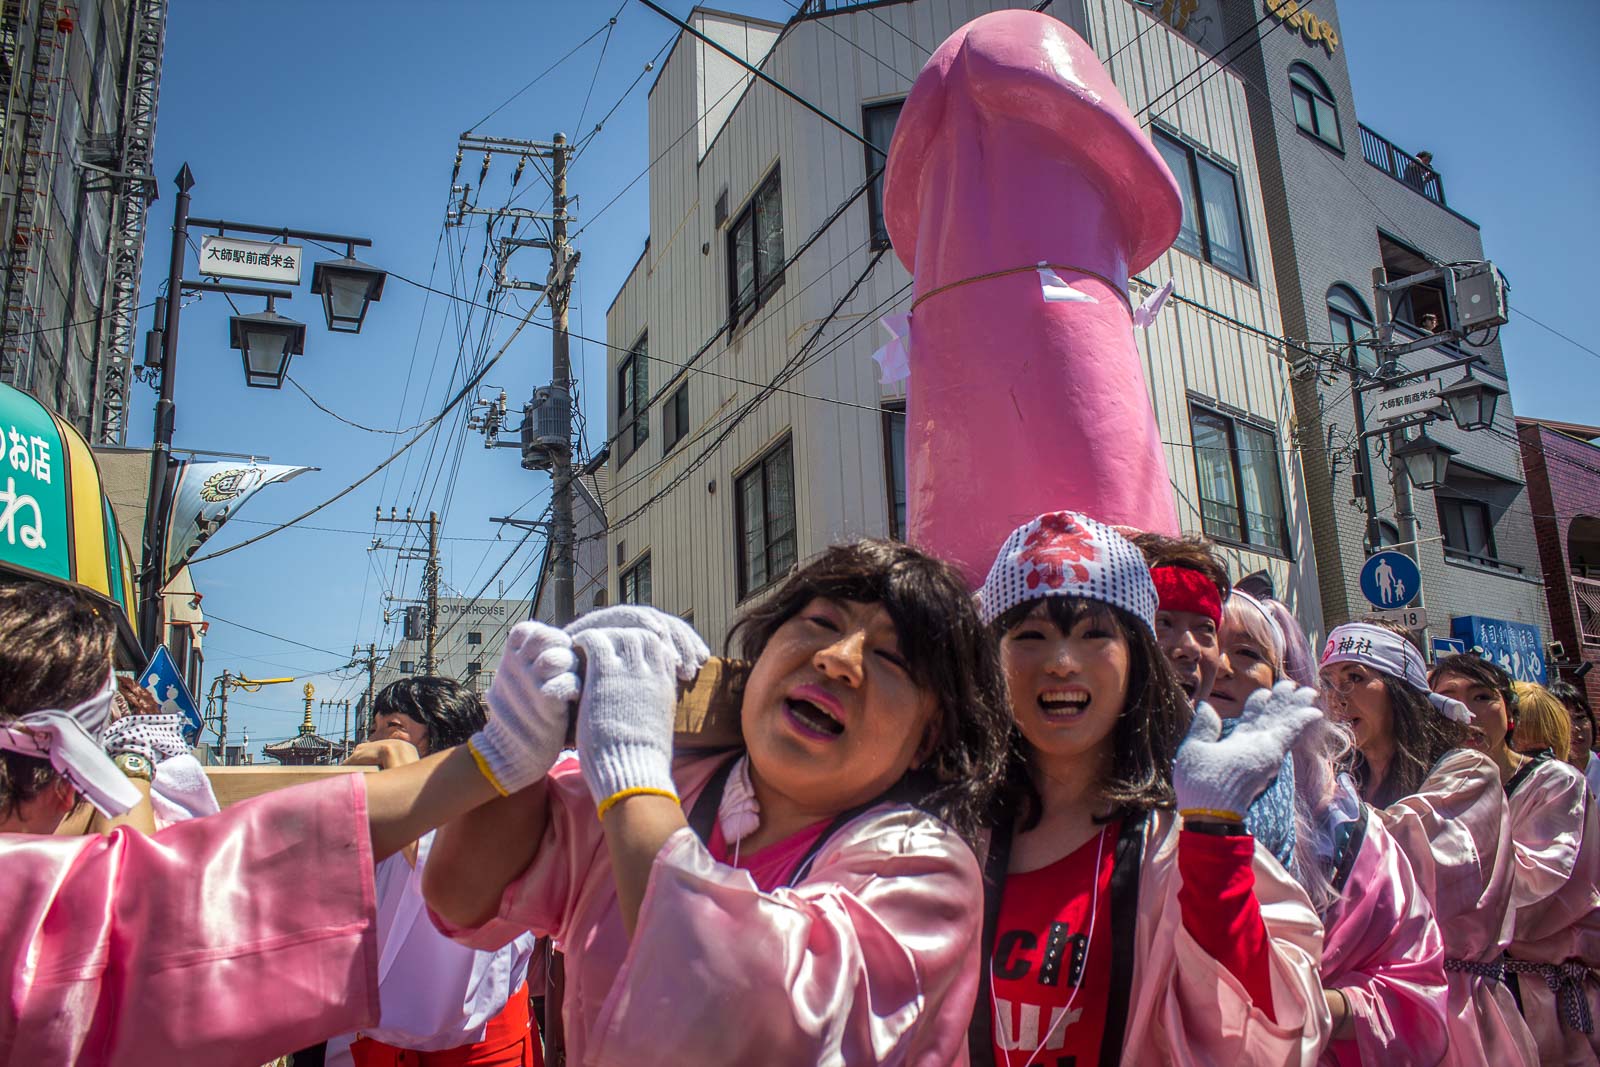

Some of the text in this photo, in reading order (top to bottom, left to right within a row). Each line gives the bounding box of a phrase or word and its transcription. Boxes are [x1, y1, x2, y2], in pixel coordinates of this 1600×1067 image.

[207, 247, 296, 270] 大師駅前商栄会
[1379, 388, 1437, 411] 大師駅前商栄会
[436, 604, 505, 616] POWERHOUSE
[1337, 636, 1373, 656] 神社
